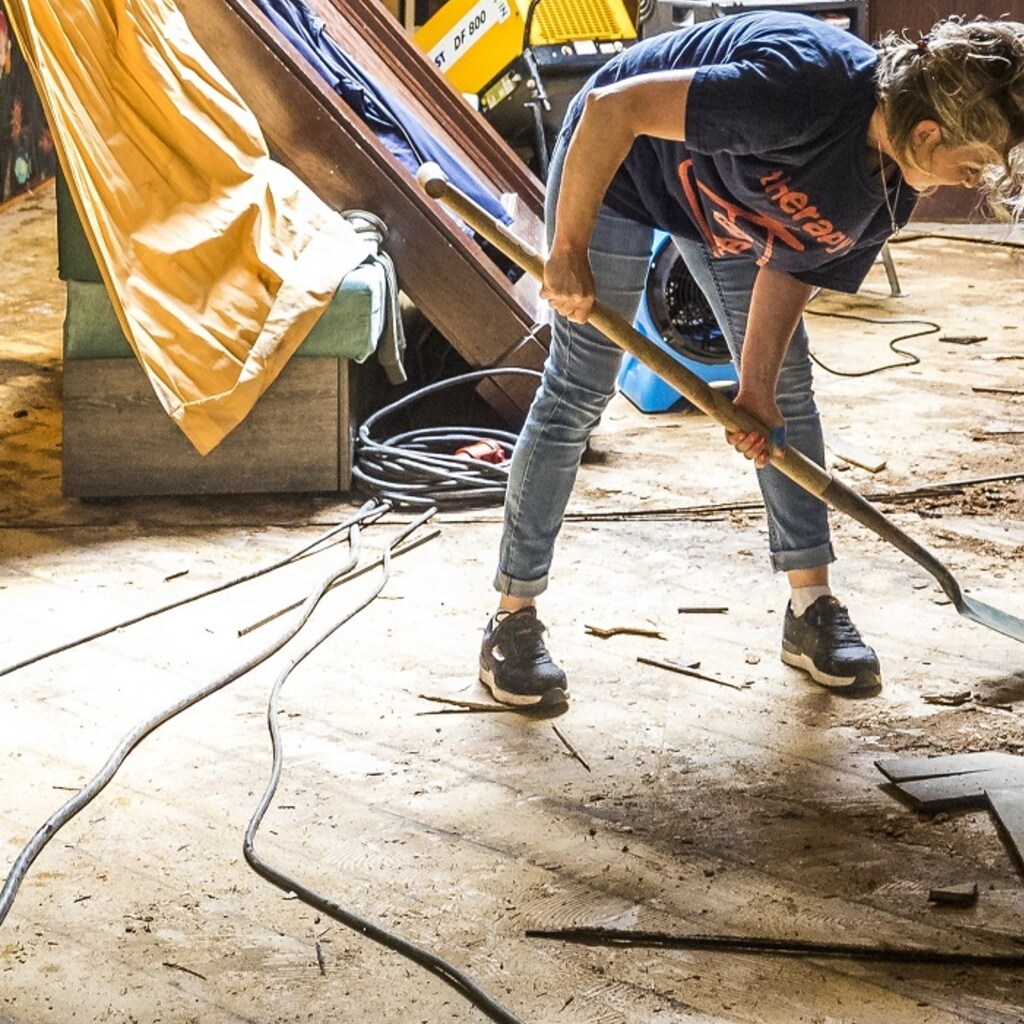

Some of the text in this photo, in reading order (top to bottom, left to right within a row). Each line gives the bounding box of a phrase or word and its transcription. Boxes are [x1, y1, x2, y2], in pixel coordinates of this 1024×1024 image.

[434, 9, 487, 68] ST DF 800
